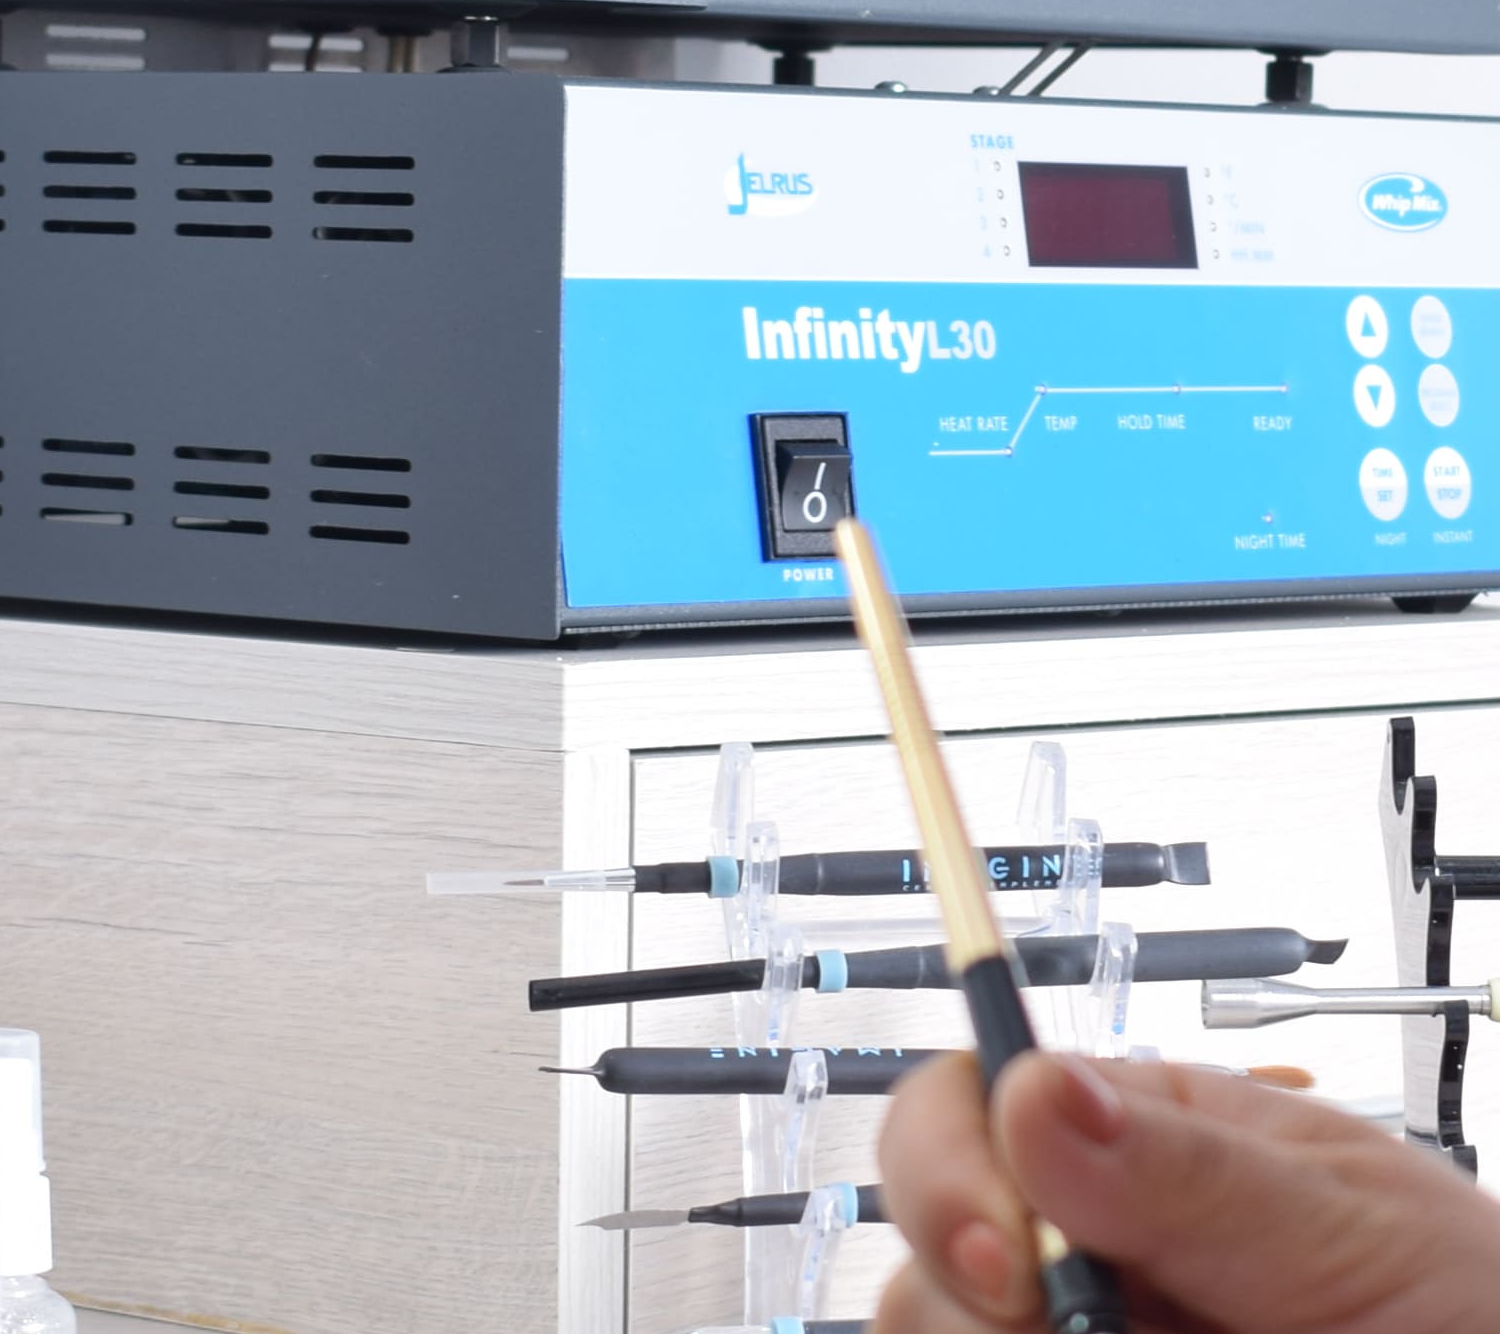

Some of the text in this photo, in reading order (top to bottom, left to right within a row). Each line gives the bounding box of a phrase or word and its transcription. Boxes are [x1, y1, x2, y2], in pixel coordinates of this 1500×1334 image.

[970, 134, 1015, 149] STAGE
[727, 152, 814, 216] JELRUS
[1371, 193, 1412, 217] Whip
[939, 416, 1009, 432] HEAT RATE
[1044, 415, 1077, 431] TEMP
[1117, 414, 1187, 430] HOLD TIME
[1252, 416, 1293, 431] READY
[1234, 534, 1307, 550] NIGHT TIME
[782, 567, 834, 581] POWER
